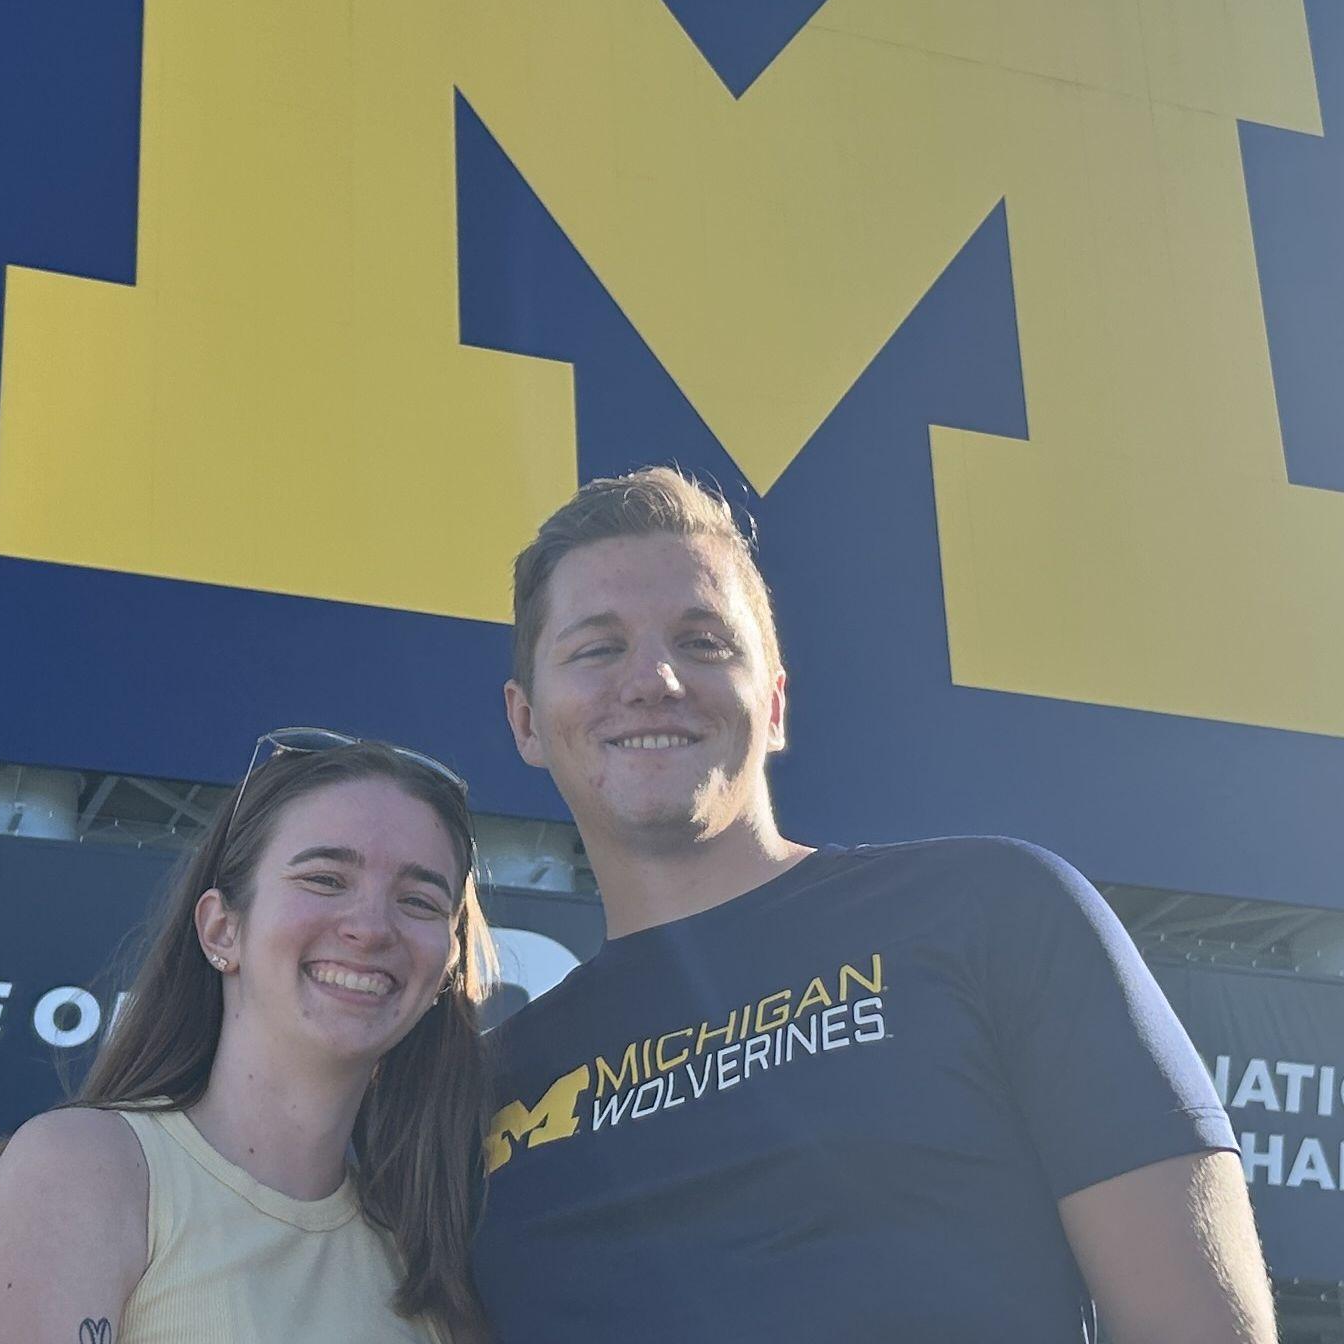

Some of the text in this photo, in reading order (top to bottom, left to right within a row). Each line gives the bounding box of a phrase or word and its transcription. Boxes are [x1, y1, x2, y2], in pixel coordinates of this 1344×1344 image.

[593, 996, 886, 1131] WOLVERINES
[595, 953, 883, 1098] MICHIGAN
[483, 1063, 590, 1174] M
